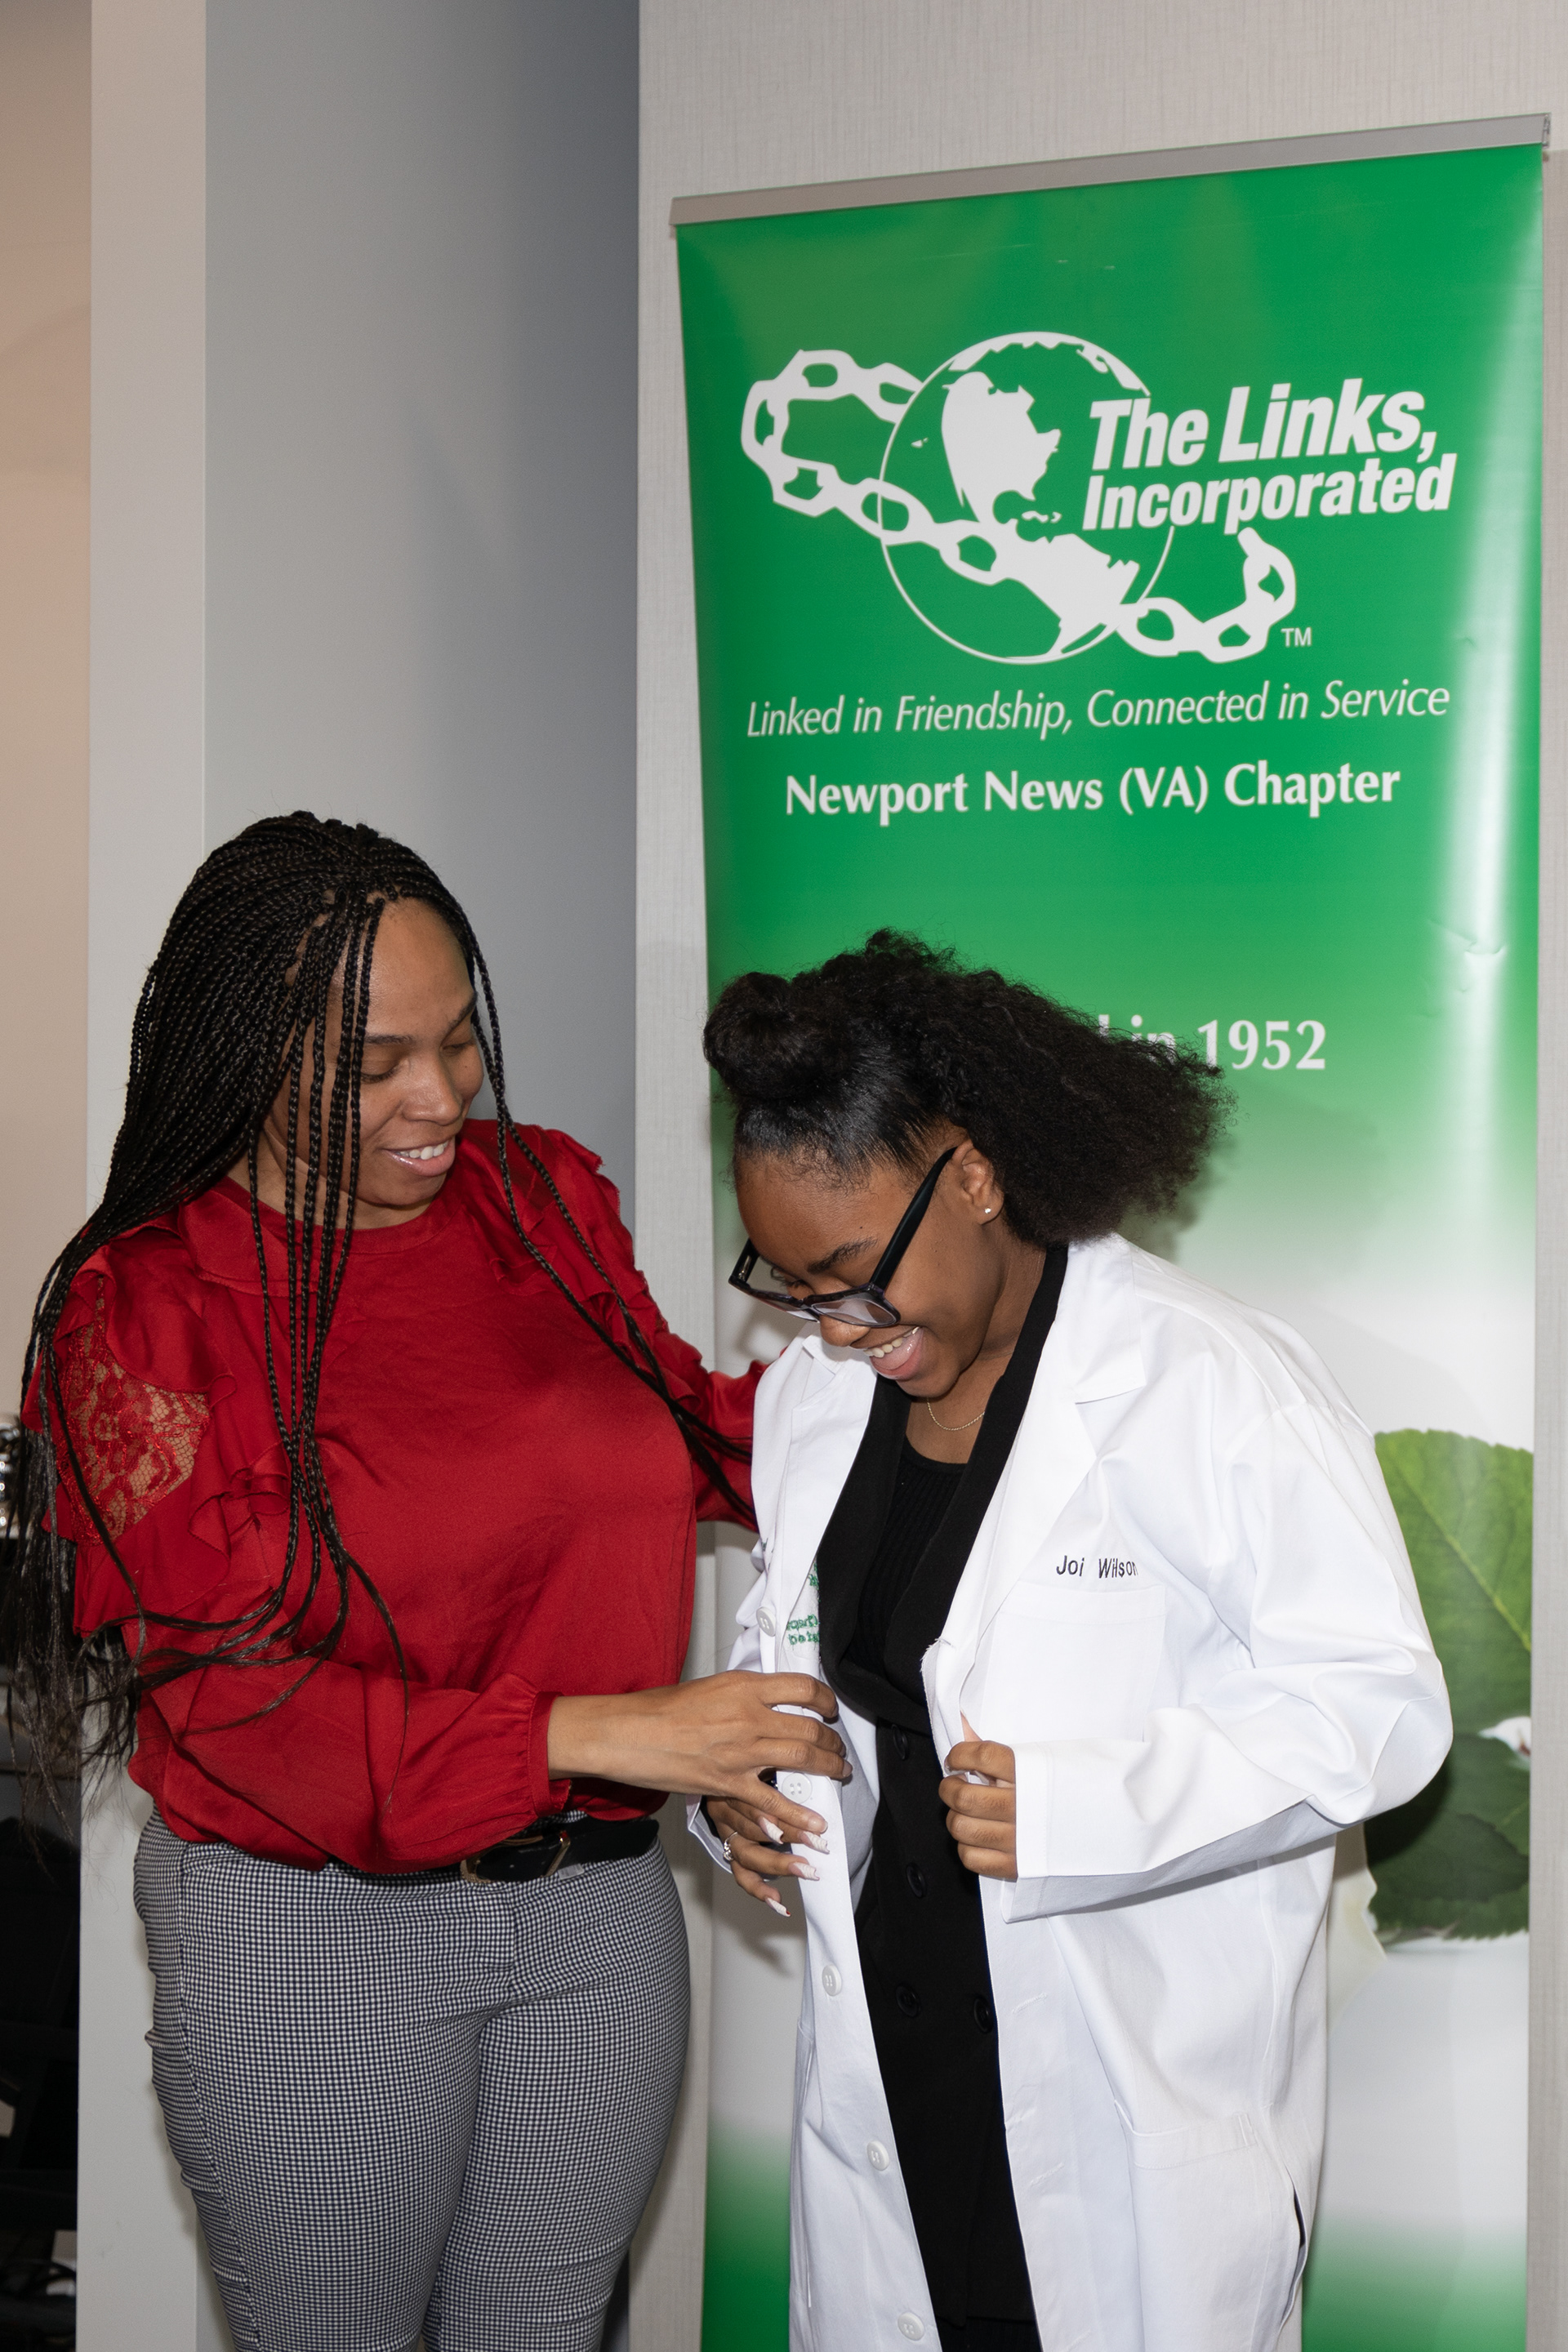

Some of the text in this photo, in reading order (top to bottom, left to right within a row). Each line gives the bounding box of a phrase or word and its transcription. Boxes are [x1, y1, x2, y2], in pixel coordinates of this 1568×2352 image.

[1089, 377, 1438, 470] The Links,
[1081, 452, 1459, 535] Incorporated
[1281, 626, 1312, 648] TM
[746, 679, 1451, 741] Linked in Friendship, Connected in Service
[786, 759, 1402, 827] Newport News (VA) Chapter
[1196, 1018, 1326, 1071] 1952
[1055, 1554, 1139, 1579] Joi Wilson
